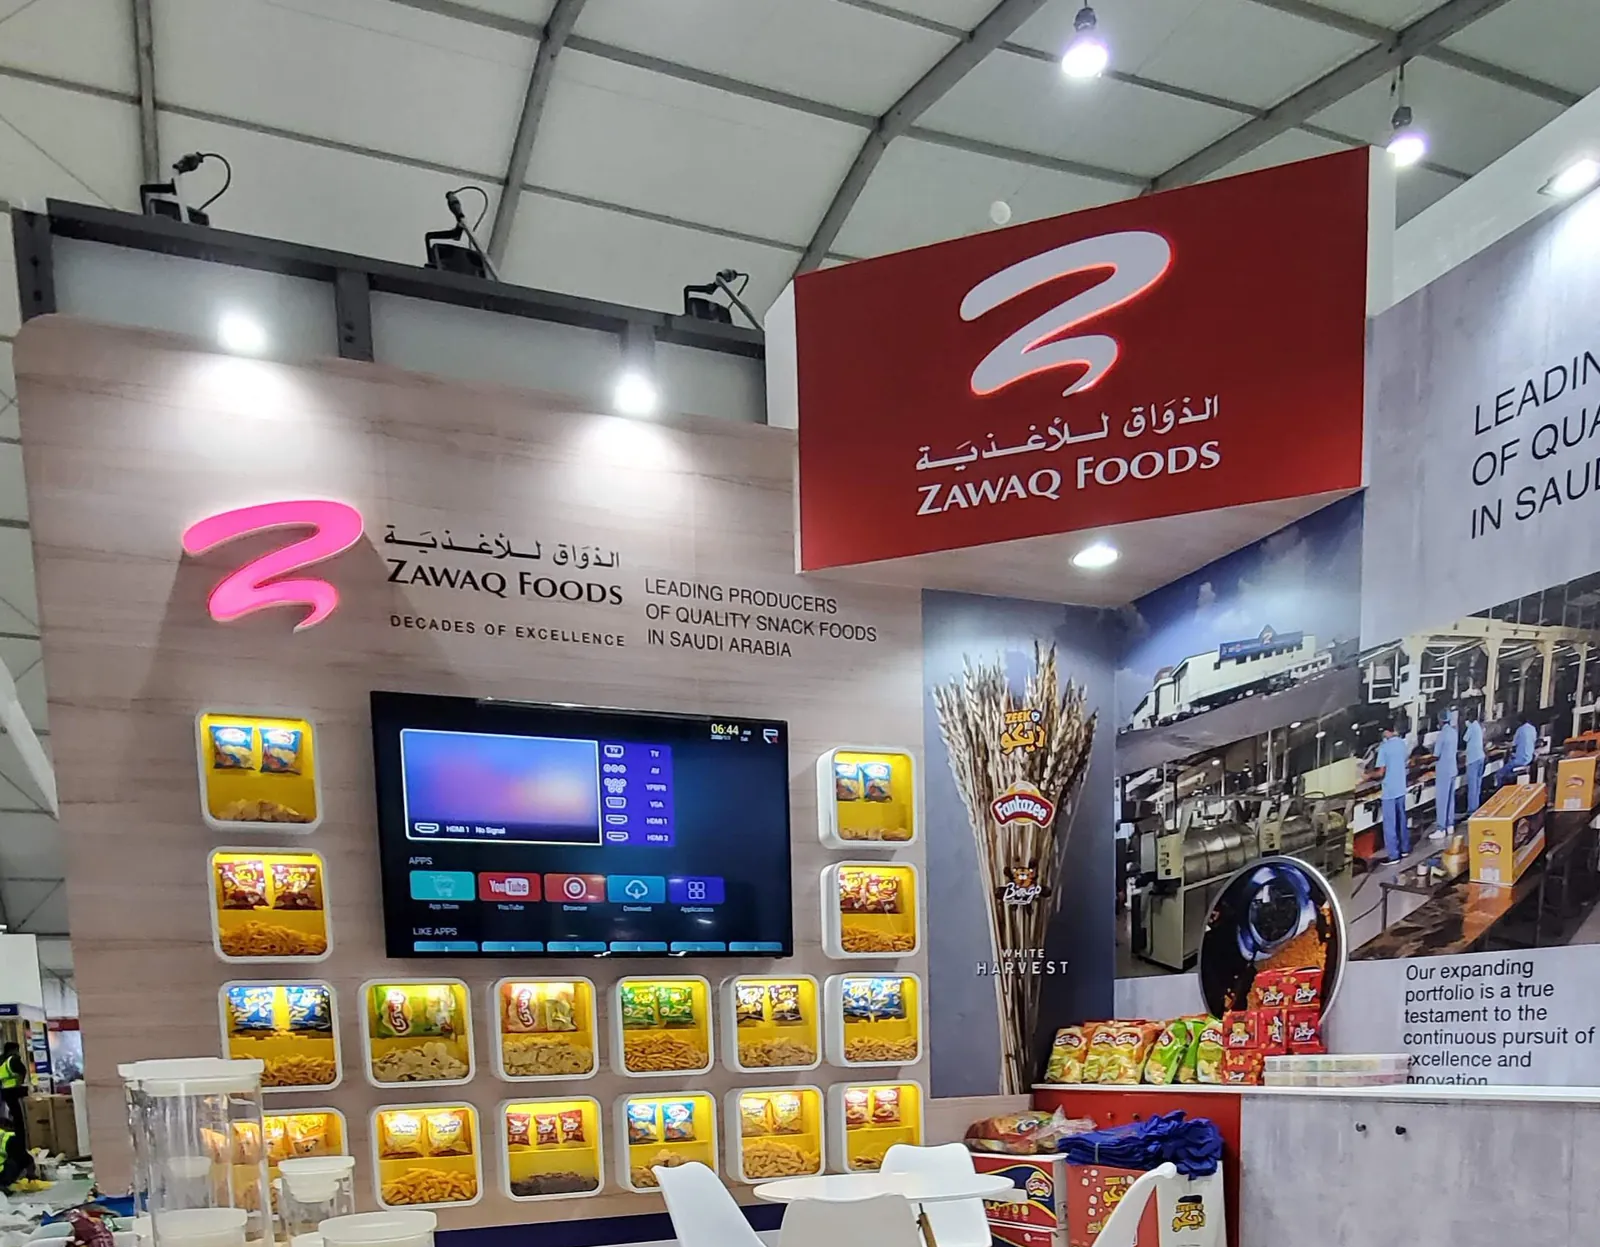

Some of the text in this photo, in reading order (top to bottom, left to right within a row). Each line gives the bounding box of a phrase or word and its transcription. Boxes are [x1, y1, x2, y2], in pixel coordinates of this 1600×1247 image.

[1472, 438, 1521, 486] OF
[916, 440, 1221, 516] ZAWAQ FOODS
[1471, 456, 1600, 540] IN SAU
[387, 558, 623, 606] ZAWAQ FOODS
[645, 578, 837, 614] LEADING PRODUCERS
[390, 614, 625, 647] DECADES OF EXCELLENCE
[645, 603, 877, 642] OF QUALITY SNACK FOODS
[648, 629, 792, 658] IN SAUDI ARABIA
[710, 723, 739, 736] 06:44
[650, 801, 664, 809] VGA
[995, 795, 1047, 821] Fantazee
[486, 826, 506, 835] Signal
[408, 857, 433, 865] APPS
[489, 878, 529, 896] YouTube
[1003, 882, 1042, 904] Bingo
[412, 927, 458, 936] LIKE APPS
[1002, 948, 1045, 959] WHITE
[976, 961, 1068, 975] HARVEST
[1406, 958, 1534, 981] Our expanding
[1405, 982, 1554, 1005] portfolio is a true
[1404, 1004, 1548, 1023] testament to the
[1403, 1026, 1596, 1048] continuous pursuit of
[1497, 1051, 1532, 1067] and
[1406, 1073, 1488, 1085] nnovation
